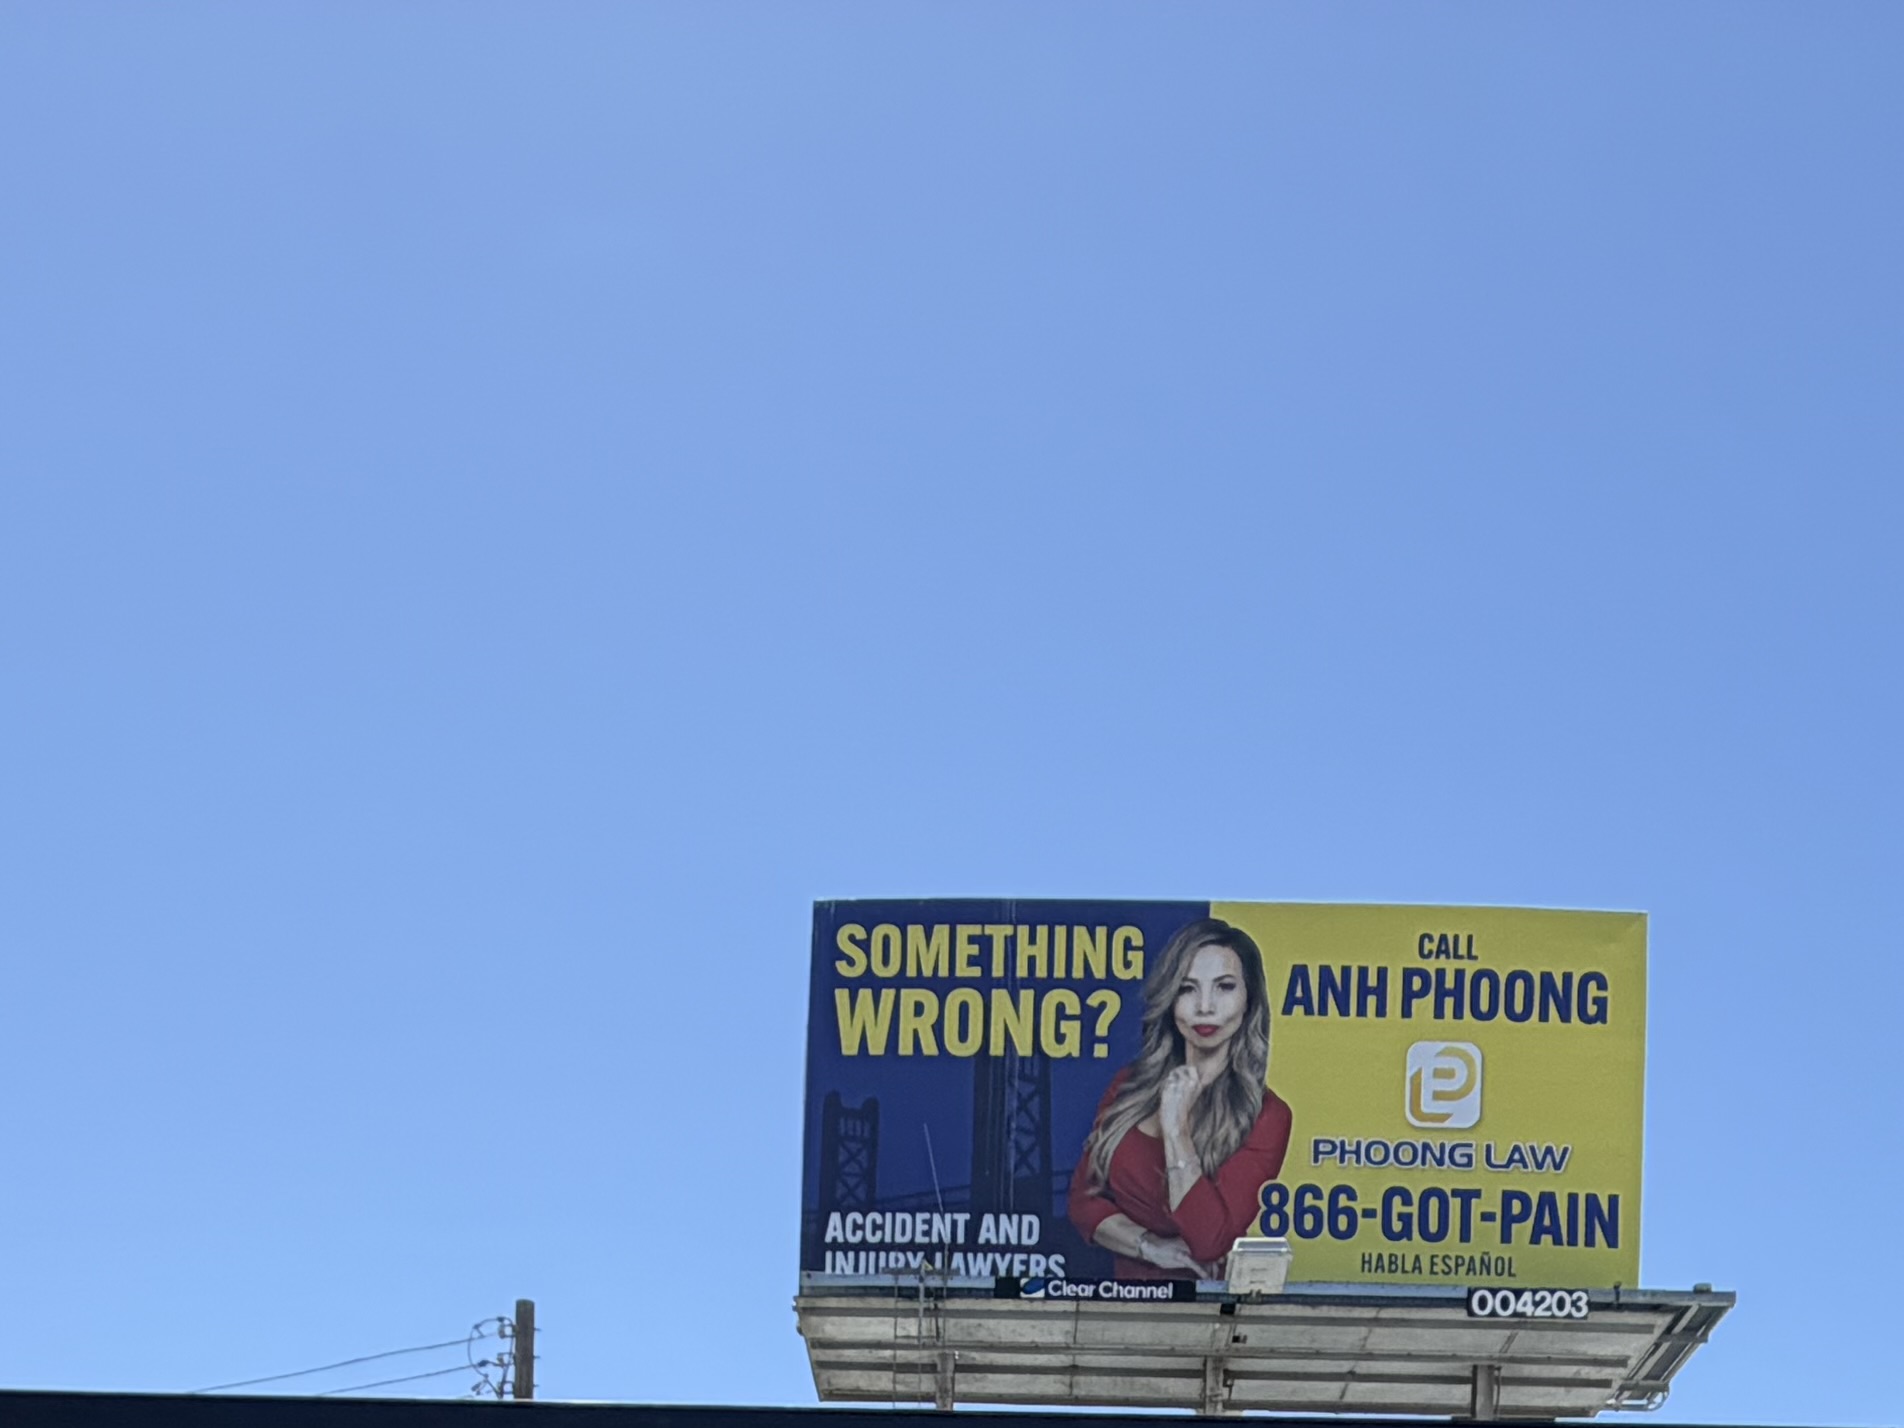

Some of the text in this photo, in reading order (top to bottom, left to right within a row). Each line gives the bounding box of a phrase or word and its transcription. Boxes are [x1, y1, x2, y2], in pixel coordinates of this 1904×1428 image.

[835, 923, 1145, 980] SOMETHING
[1418, 933, 1479, 961] CALL
[1281, 964, 1610, 1025] ANH PHOONG
[834, 987, 1122, 1058] WRONG?
[1311, 1138, 1571, 1172] PHOONG LAW
[825, 1212, 1040, 1246] ACCIDENT AND
[1259, 1182, 1620, 1249] 866-GOT-PAIN
[1361, 1251, 1517, 1278] HABLA ESPAÑOL
[1048, 1280, 1174, 1300] Clear Channel
[1471, 1290, 1589, 1318] 004203
